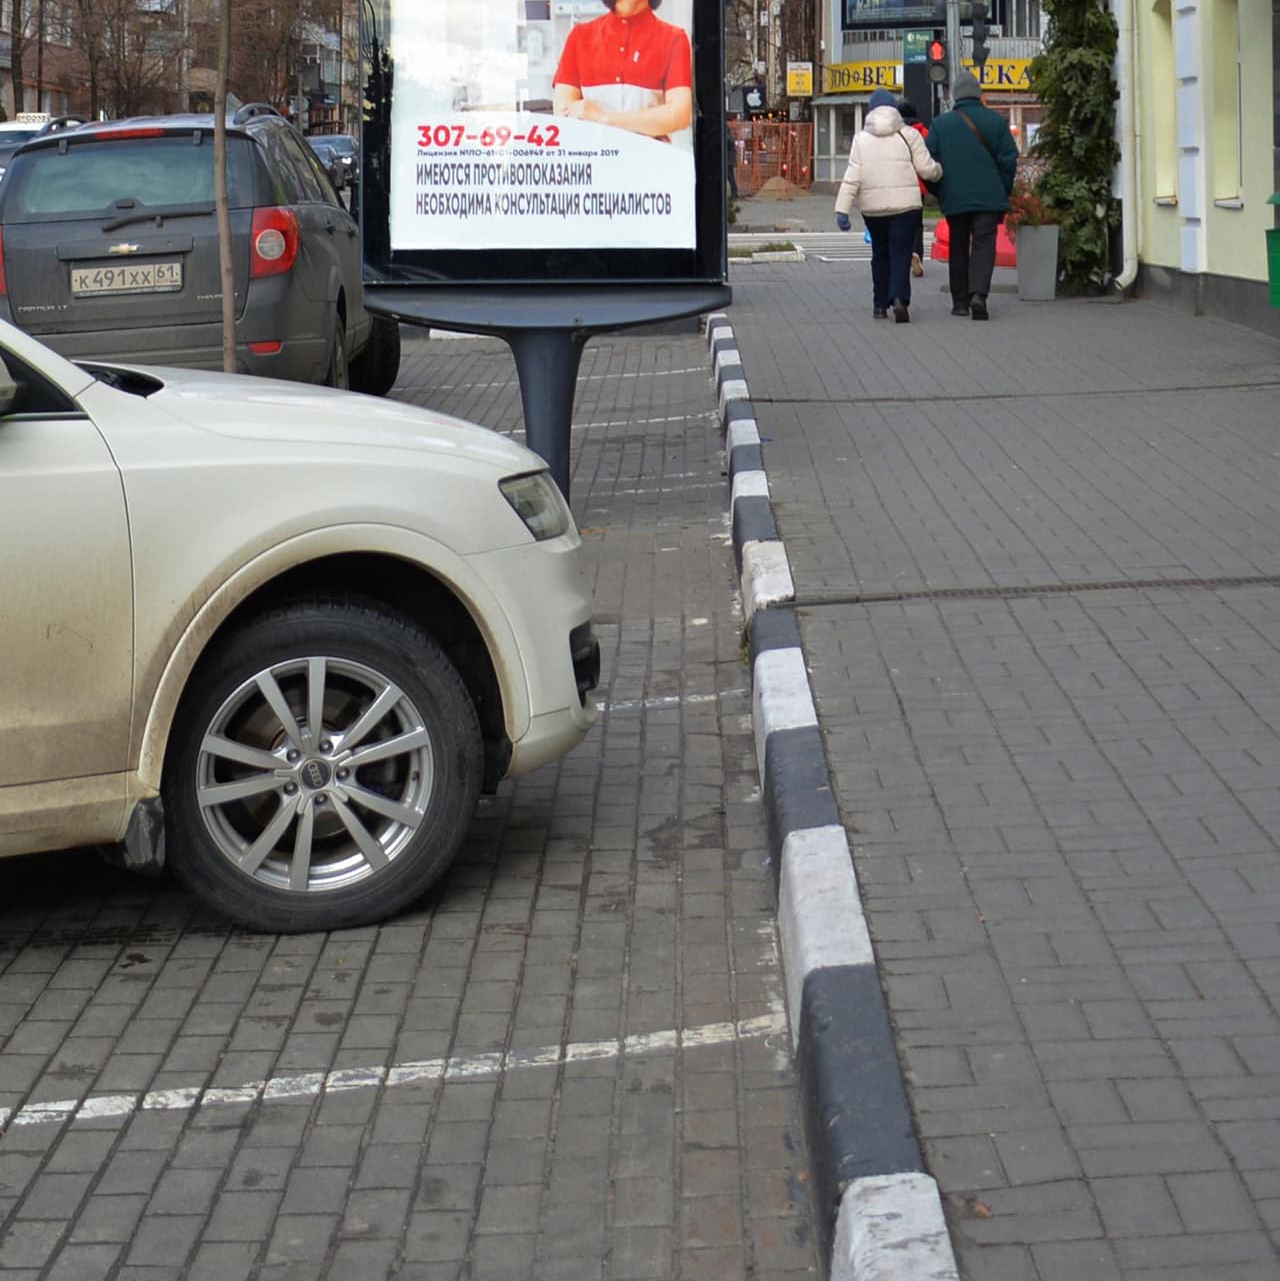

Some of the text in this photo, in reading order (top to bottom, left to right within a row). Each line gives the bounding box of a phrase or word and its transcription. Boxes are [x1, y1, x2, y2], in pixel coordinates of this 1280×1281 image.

[417, 125, 560, 147] 307-69-42
[417, 149, 457, 157] Лицензия
[557, 149, 566, 157] 31
[568, 150, 598, 158] января
[600, 149, 619, 157] 2019
[416, 163, 592, 186] ИМЕЮТСЯ ПРОТИВОПОКАЗАНИЯ
[416, 193, 672, 219] НЕОБХОДИМА КОНСУЛЬТАЦИЯ СПЕЦИАЛИСТОВ
[157, 265, 174, 280] 61
